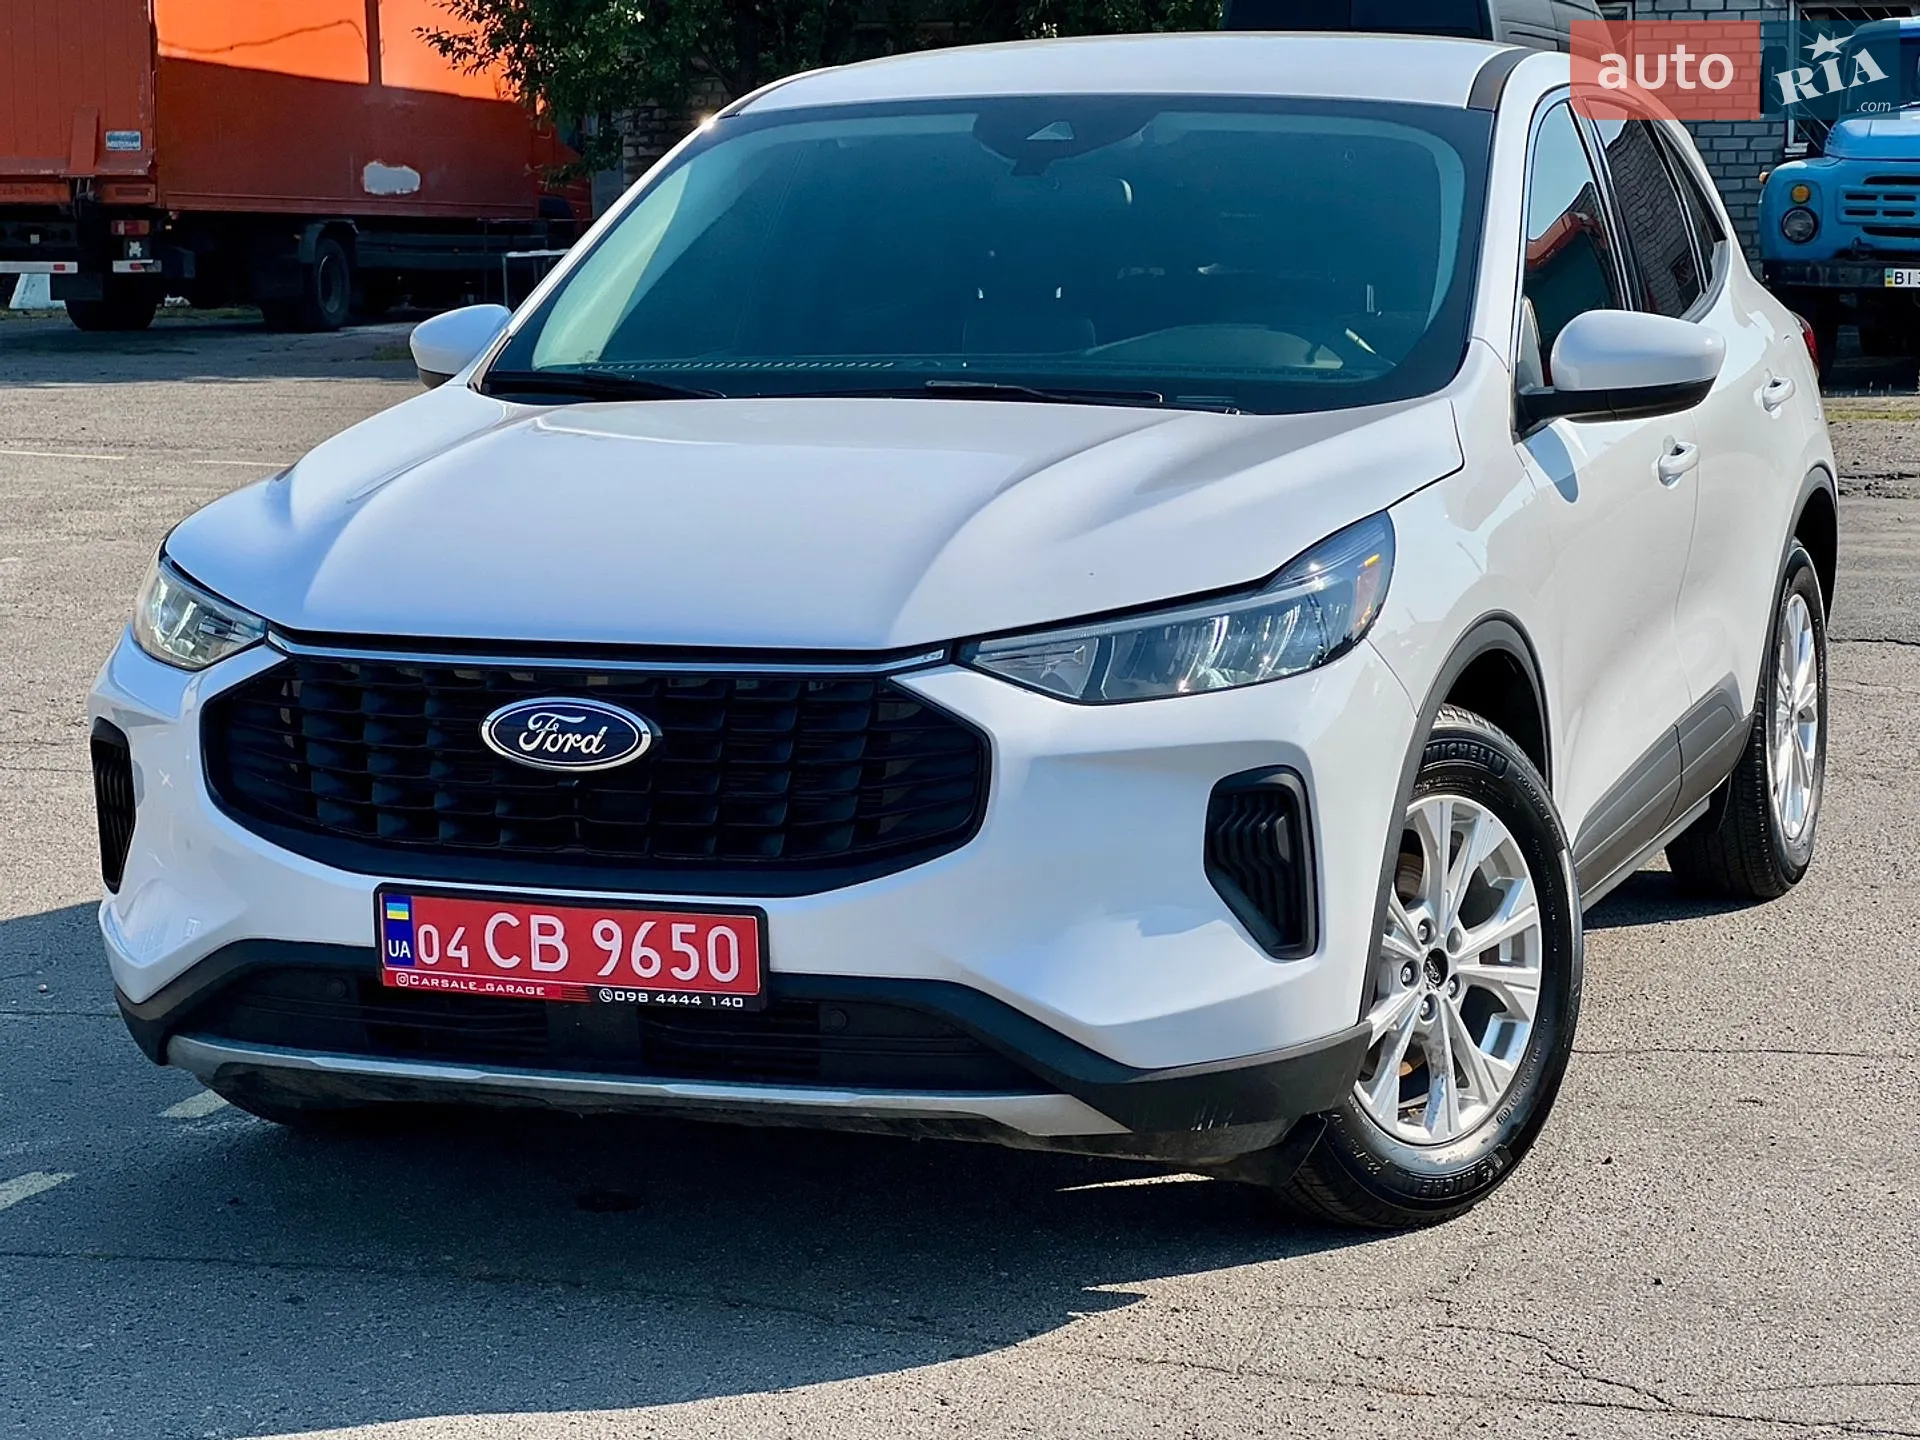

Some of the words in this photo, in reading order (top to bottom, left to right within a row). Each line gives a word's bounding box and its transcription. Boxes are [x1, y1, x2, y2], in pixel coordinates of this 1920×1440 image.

[1895, 271, 1911, 285] BI
[518, 711, 609, 755] Ford
[1424, 742, 1508, 775] MICHELIN
[388, 939, 411, 959] UA
[418, 923, 469, 969] 04
[484, 912, 570, 972] CB
[592, 919, 740, 983] 9650
[615, 991, 649, 1003] 098
[656, 993, 703, 1006] 4444
[711, 996, 744, 1008] 140
[1395, 1170, 1477, 1197] MICHEL
